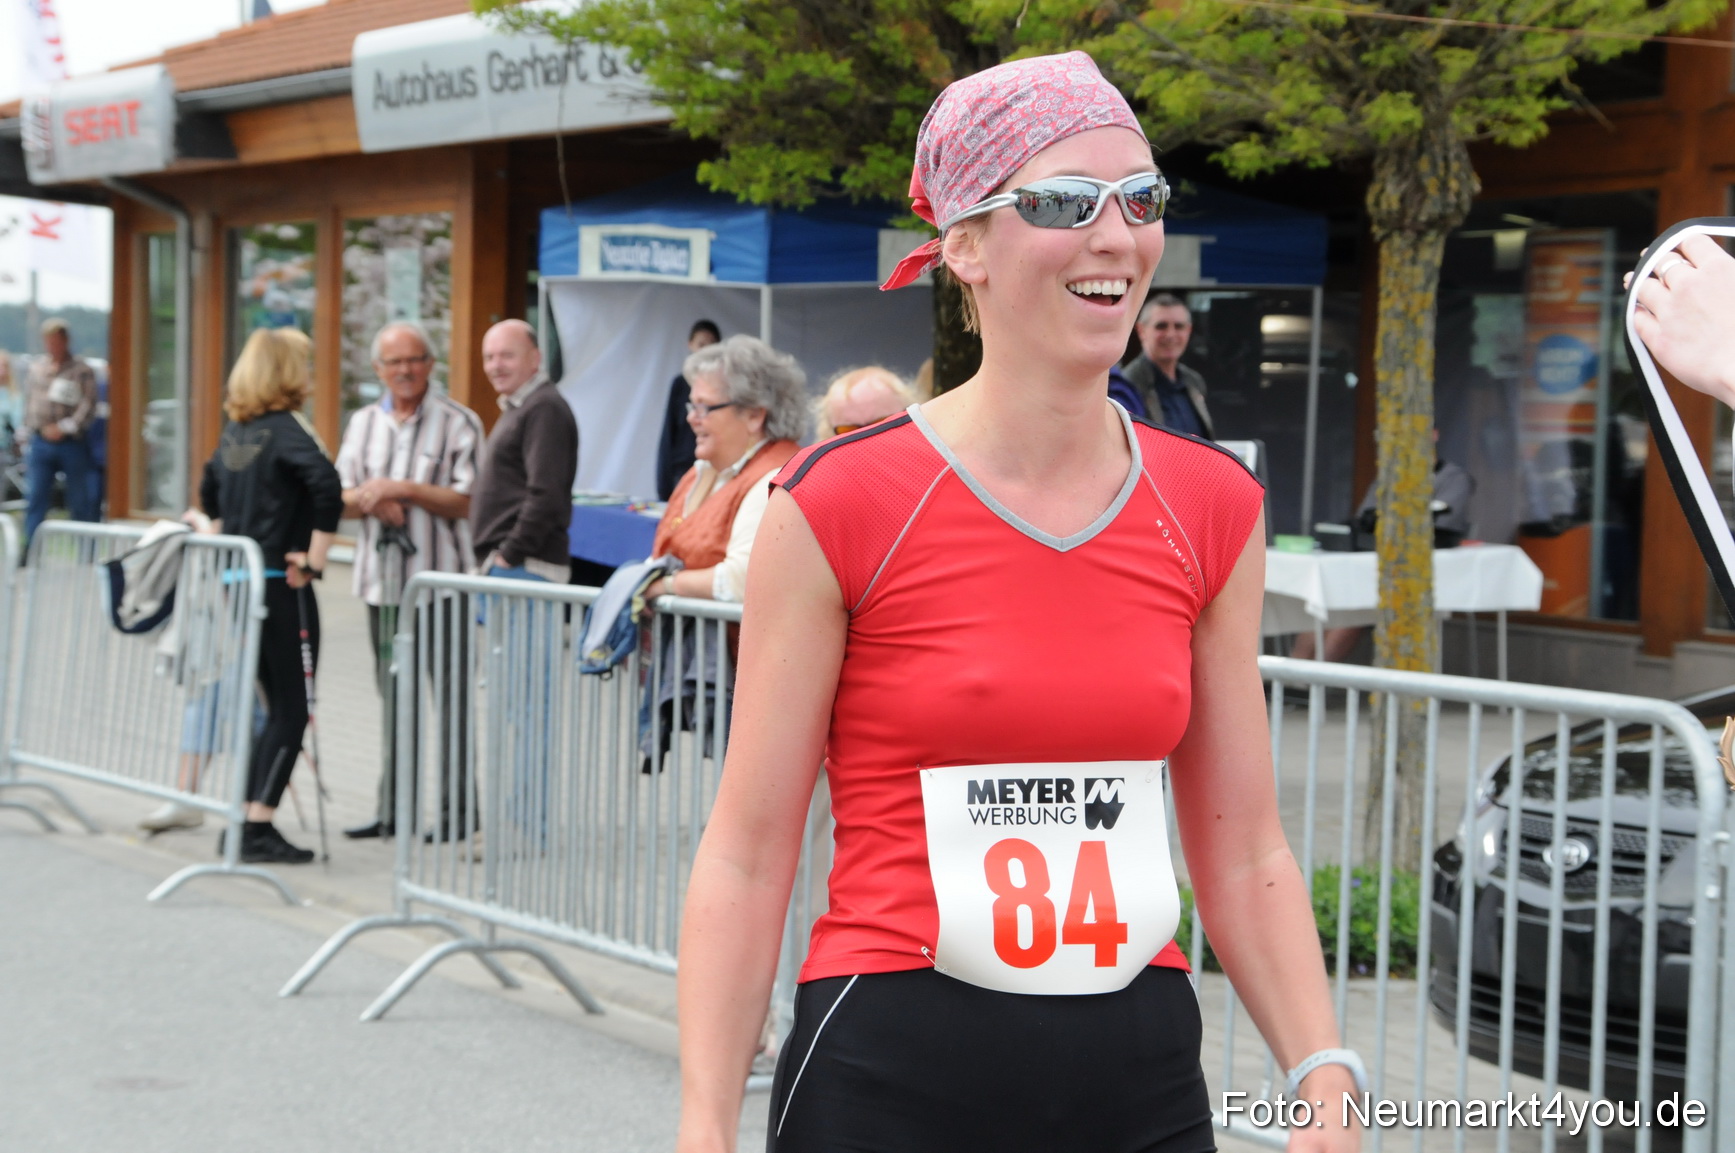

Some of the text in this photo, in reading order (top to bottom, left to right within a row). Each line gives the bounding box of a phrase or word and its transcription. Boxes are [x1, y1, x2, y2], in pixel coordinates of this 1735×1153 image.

[372, 60, 478, 111] Autohaus
[64, 100, 141, 146] SEAT
[967, 778, 1076, 804] MEYER
[968, 806, 1077, 826] WERBUNG
[983, 838, 1128, 969] 84
